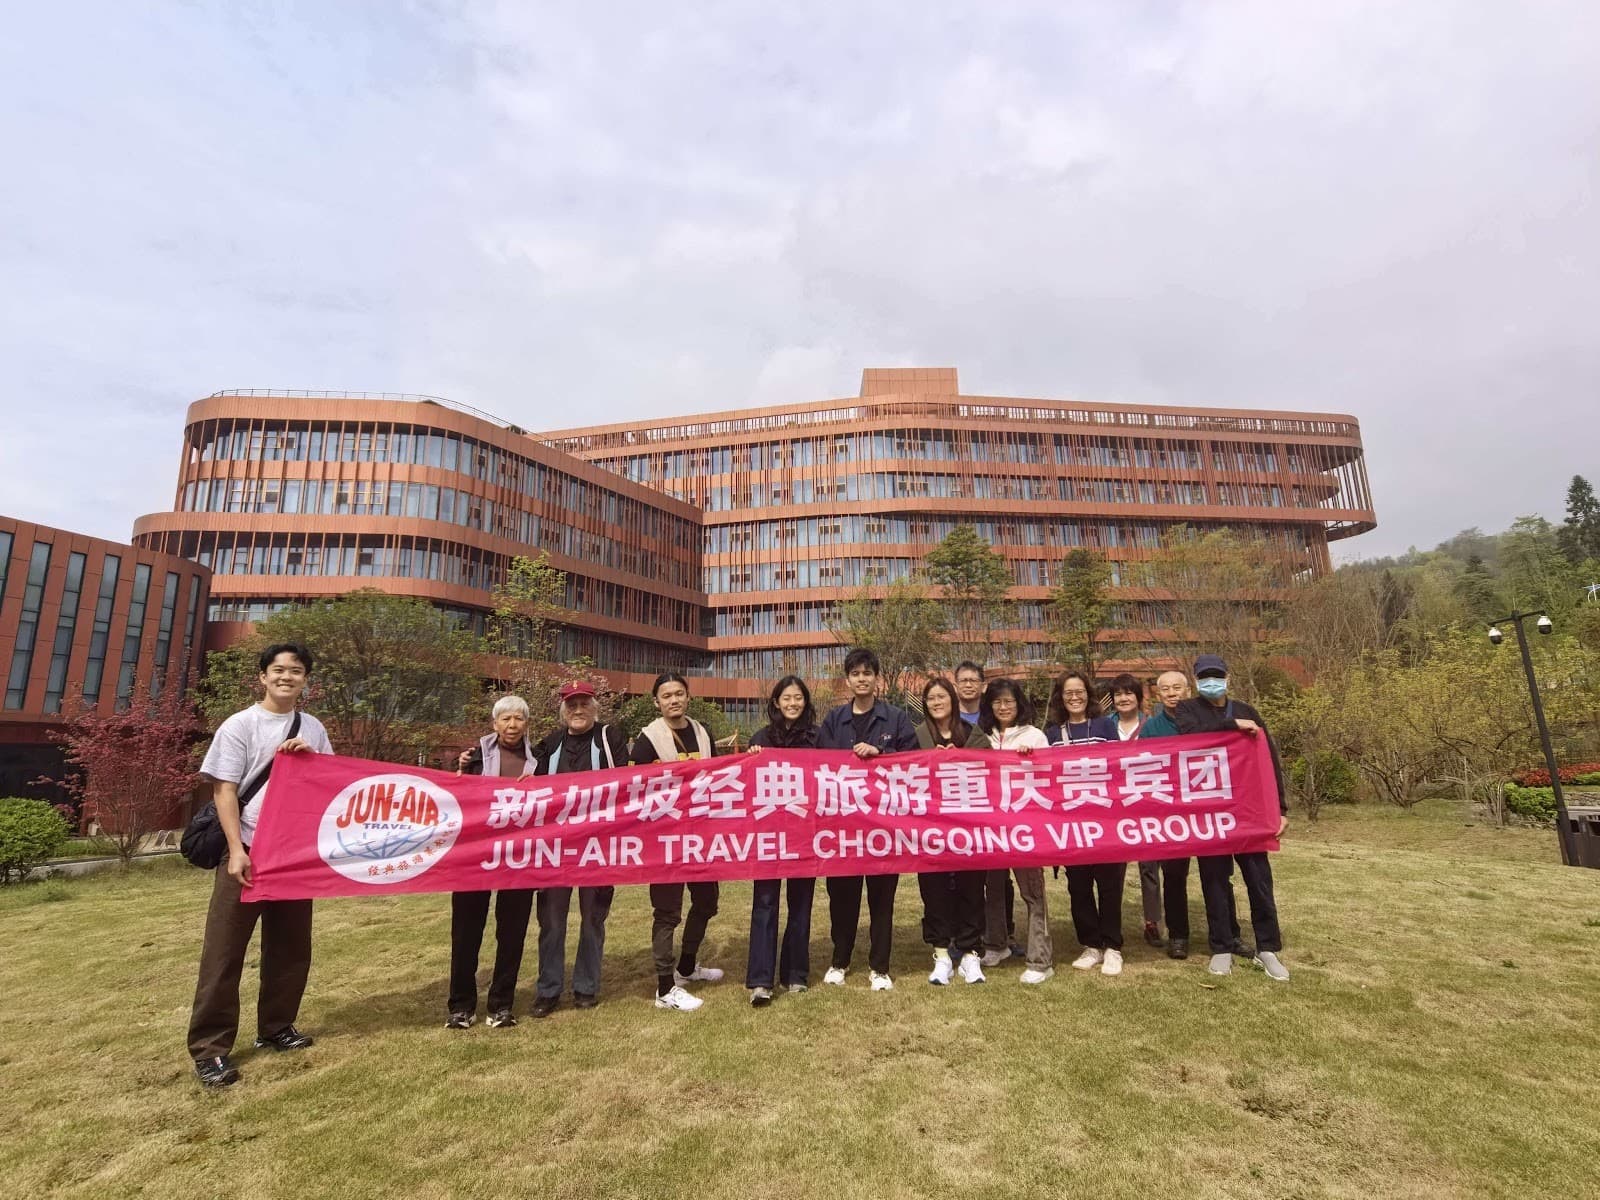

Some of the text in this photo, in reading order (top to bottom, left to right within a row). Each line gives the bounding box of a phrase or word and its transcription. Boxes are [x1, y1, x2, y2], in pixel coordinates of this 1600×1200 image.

[336, 783, 440, 829] JUN-AIR
[486, 746, 1234, 829] 新加坡经典旅游重庆贵宾团
[480, 812, 1237, 871] JUN-AIR TRAVEL CHONGQING VIP GROUP
